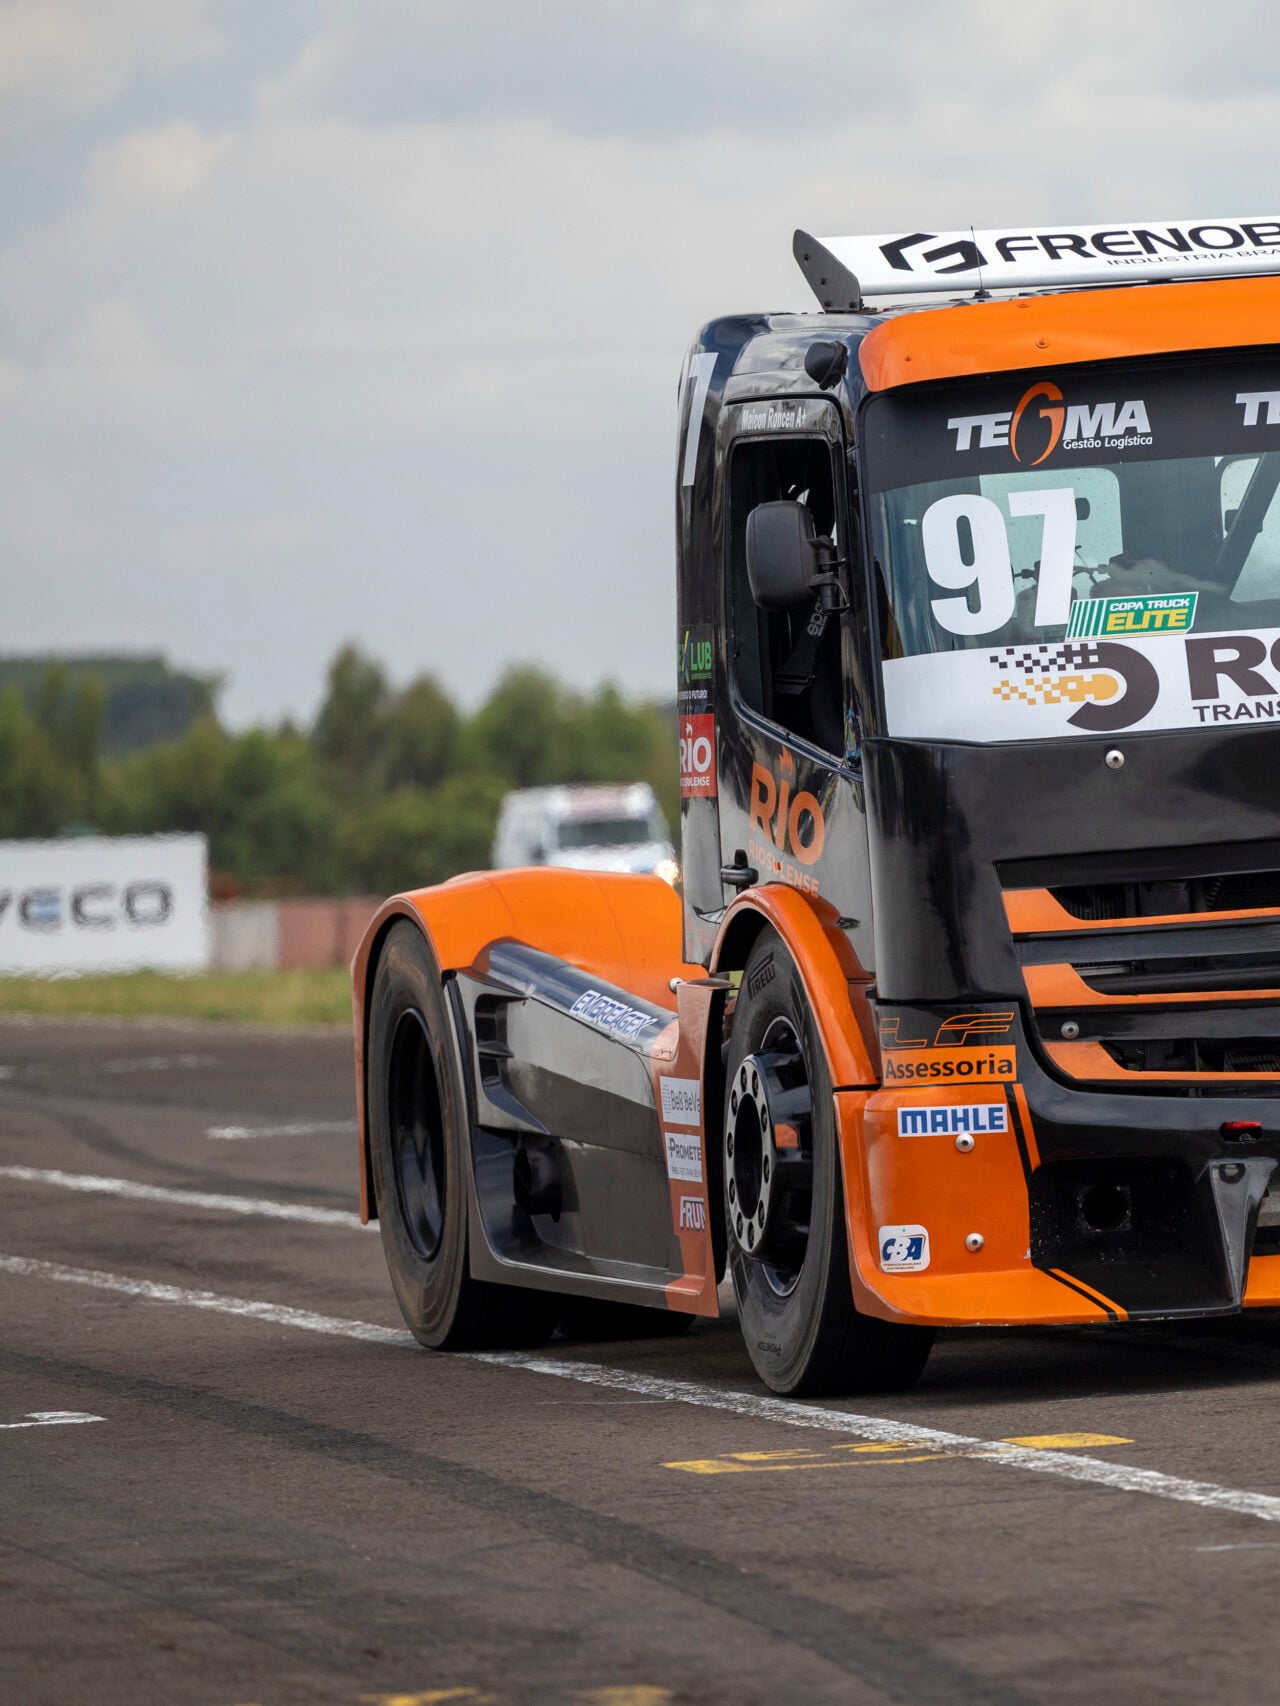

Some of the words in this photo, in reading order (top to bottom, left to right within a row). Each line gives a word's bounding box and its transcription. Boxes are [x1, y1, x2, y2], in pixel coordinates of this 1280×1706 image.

[947, 382, 1151, 466] TEGMA
[1063, 438, 1101, 450] Gestão
[1105, 435, 1153, 449] Logística
[922, 487, 1077, 636] 97
[1109, 600, 1144, 611] COPA
[1147, 597, 1190, 610] TRUCK
[1106, 609, 1188, 631] ELITE
[749, 761, 825, 867] RIO
[747, 952, 776, 1000] PIRELLI
[571, 991, 656, 1038] EMBREAGEX
[886, 1053, 1013, 1079] Assessoria
[901, 1107, 1004, 1134] MAHLE
[882, 1237, 923, 1261] CBA
